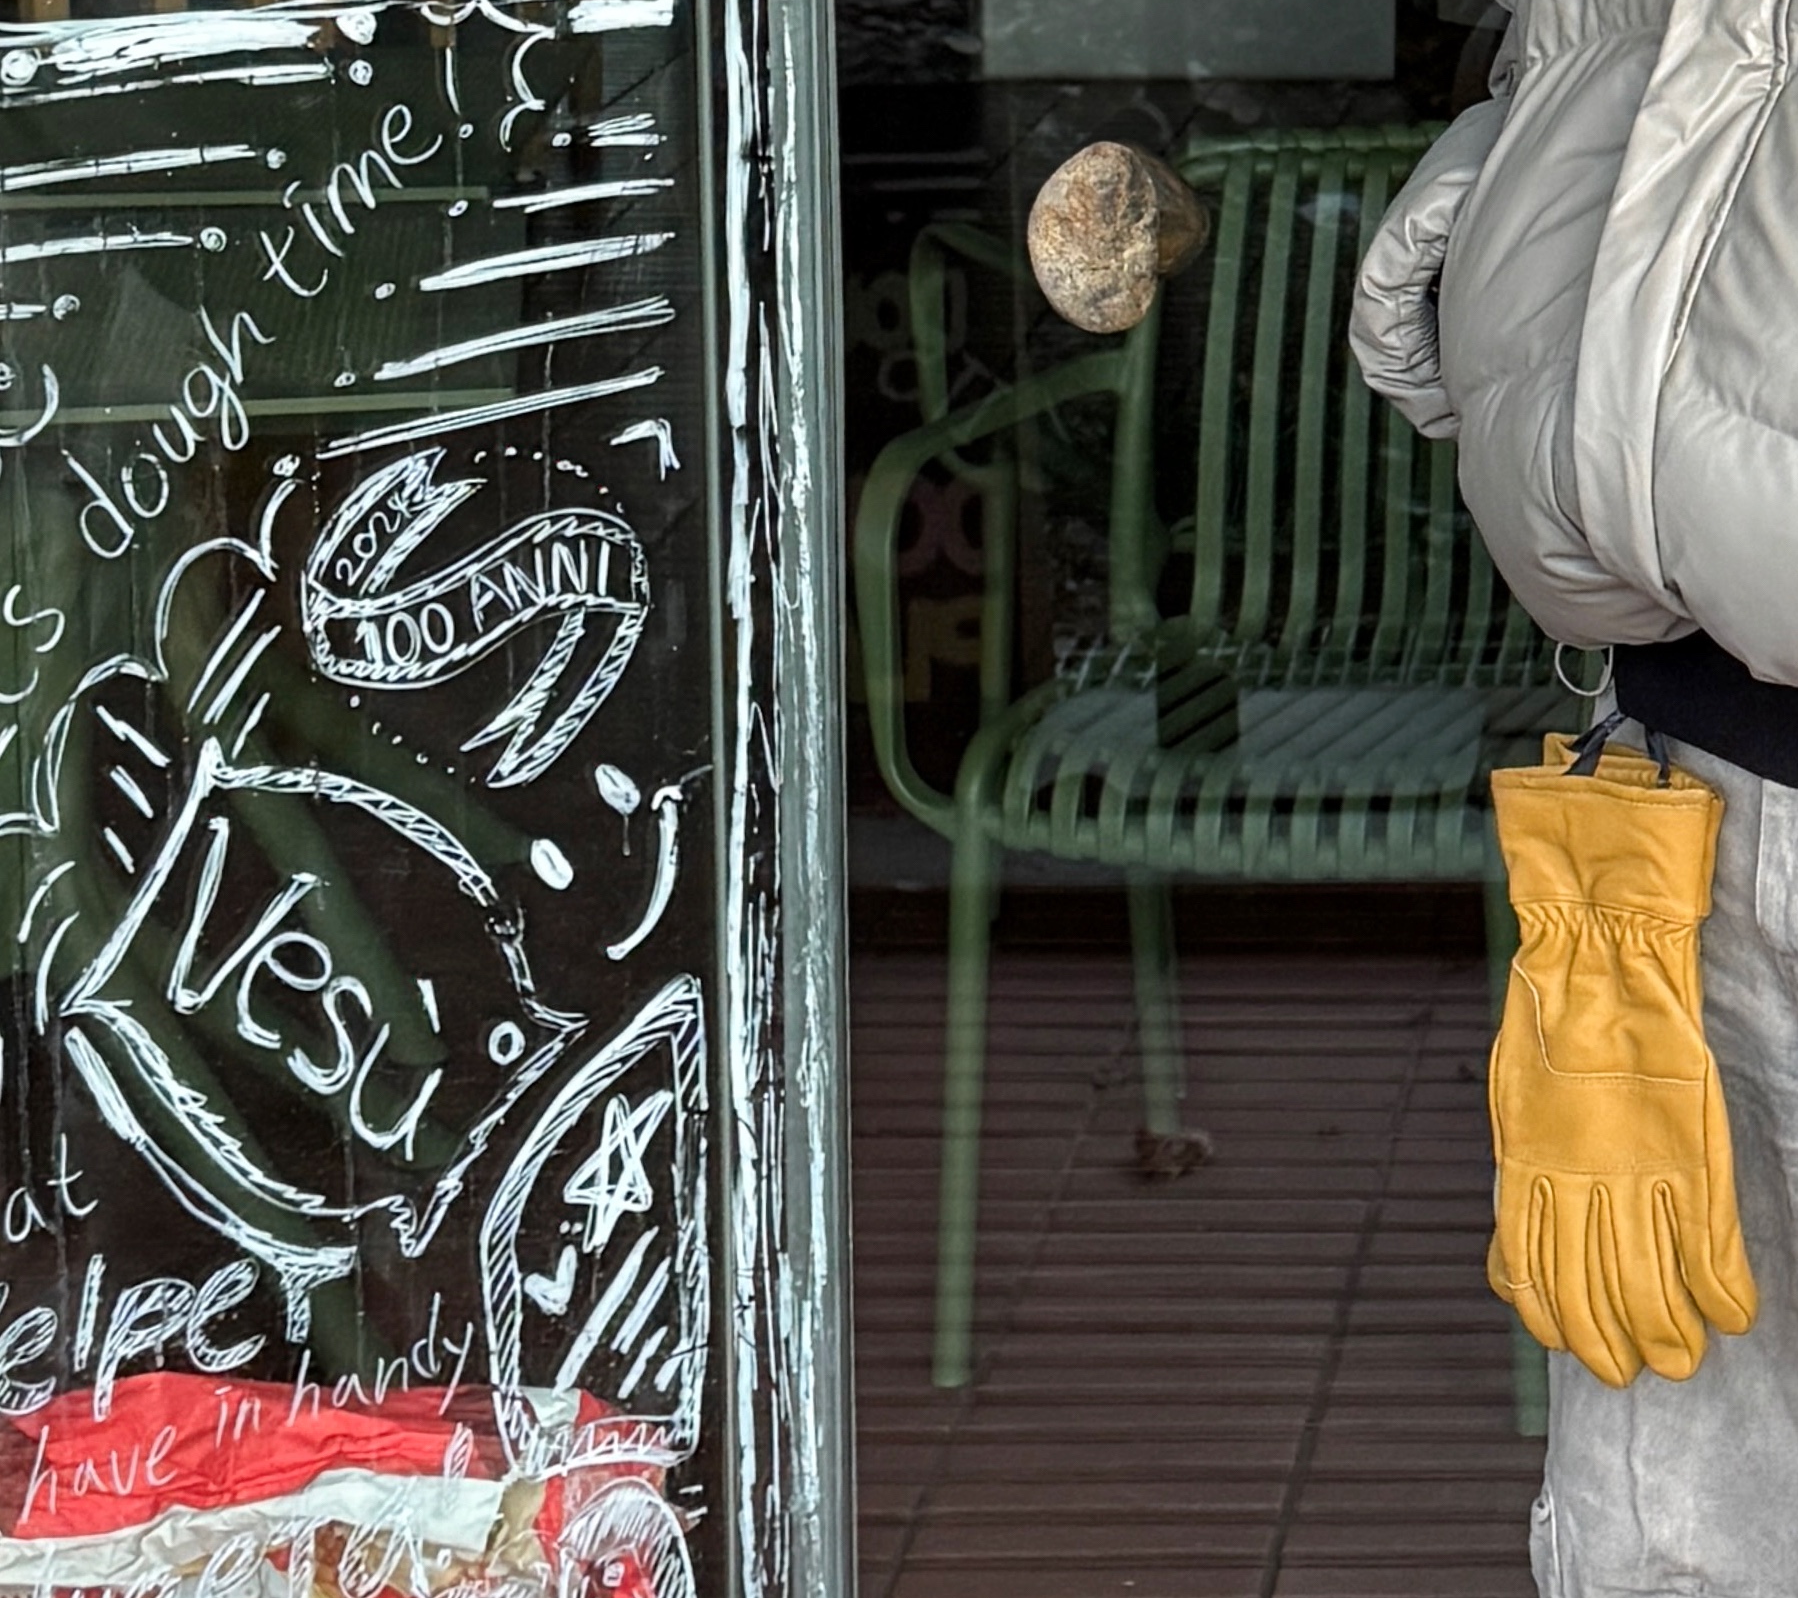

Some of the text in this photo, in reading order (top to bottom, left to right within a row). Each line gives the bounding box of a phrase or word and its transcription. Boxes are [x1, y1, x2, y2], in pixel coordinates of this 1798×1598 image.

[61, 303, 275, 559] dough
[354, 539, 612, 666] 100 ANNI
[20, 1292, 474, 1524] have in handy
